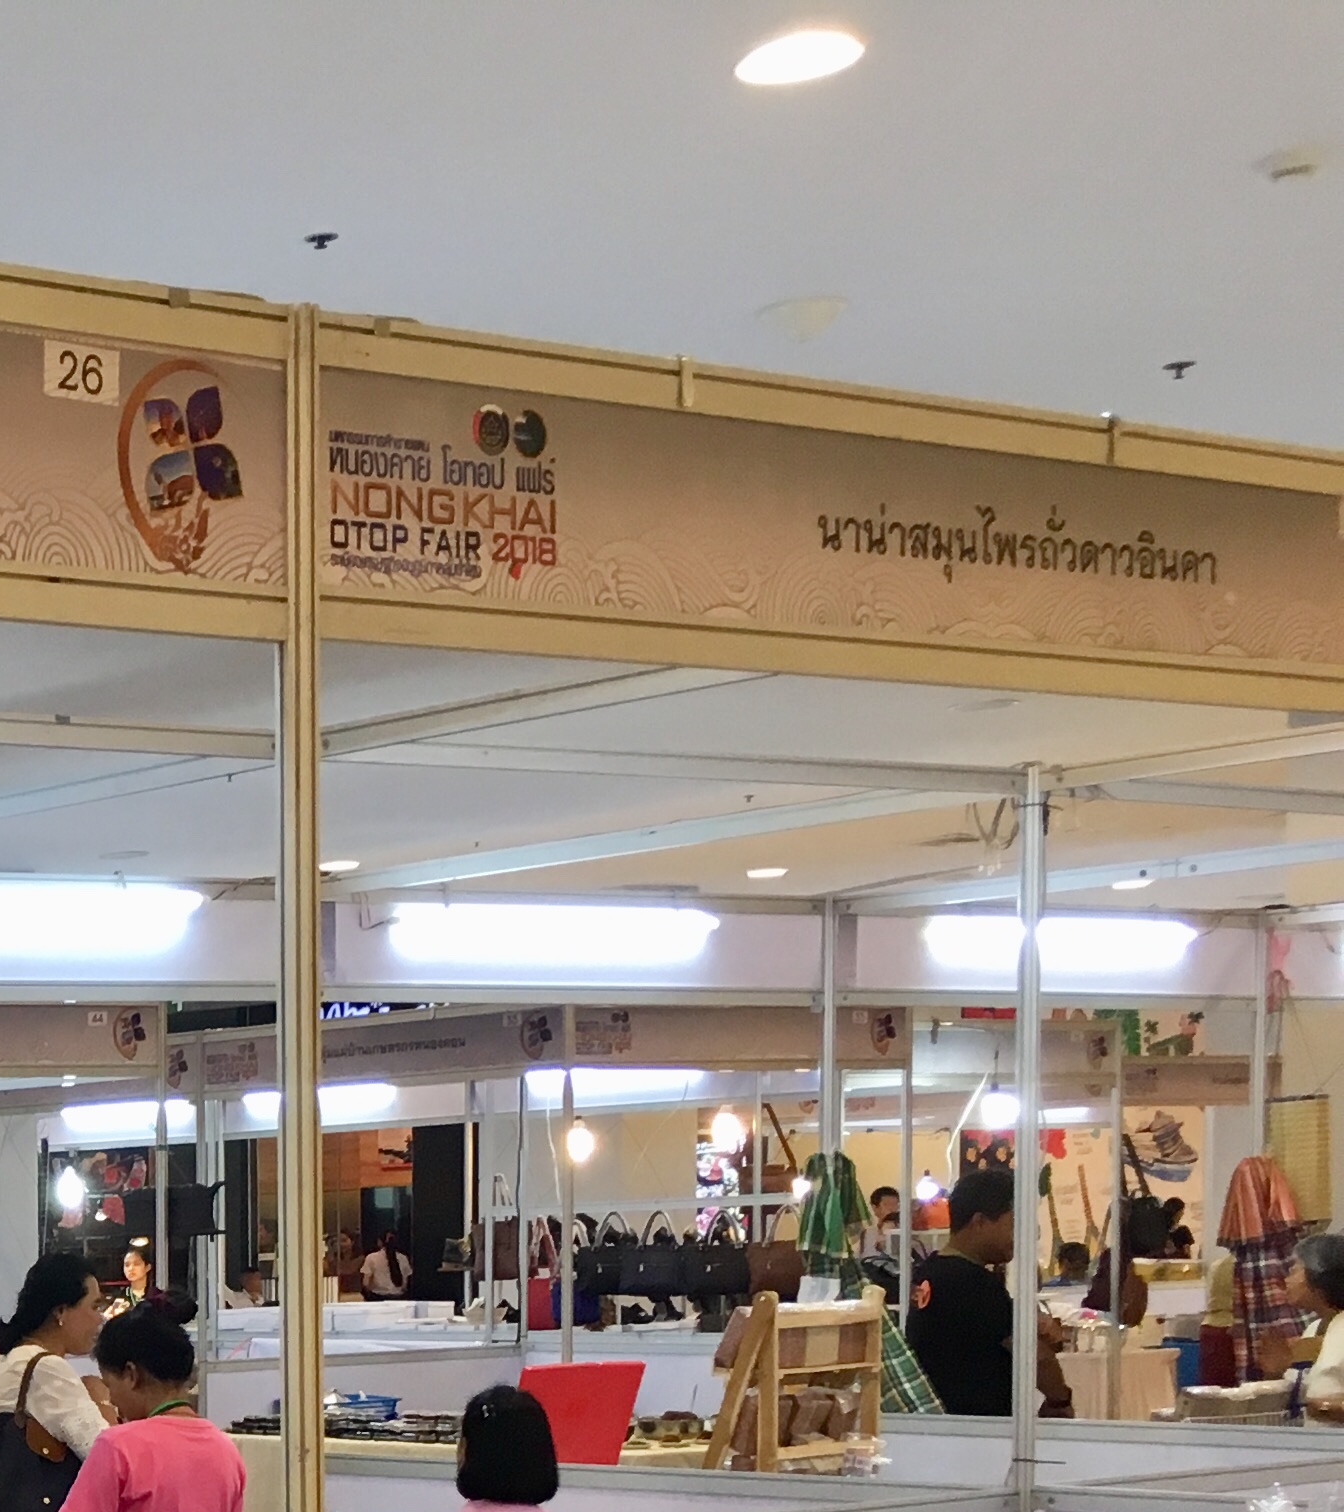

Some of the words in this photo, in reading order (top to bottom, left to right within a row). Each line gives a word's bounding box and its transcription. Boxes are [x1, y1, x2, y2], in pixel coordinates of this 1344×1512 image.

[57, 350, 104, 395] 26
[329, 446, 430, 482] หนองคาย
[442, 443, 505, 490] โอทอป
[516, 457, 556, 495] แฟร์
[329, 479, 455, 524] NONG
[463, 493, 557, 534] KHAI
[330, 518, 409, 553] OTOP
[420, 527, 482, 561] FAIR
[492, 533, 557, 566] 2018
[818, 503, 1217, 585] นาน่าสมุนไพรถั่วดาวอินคา
